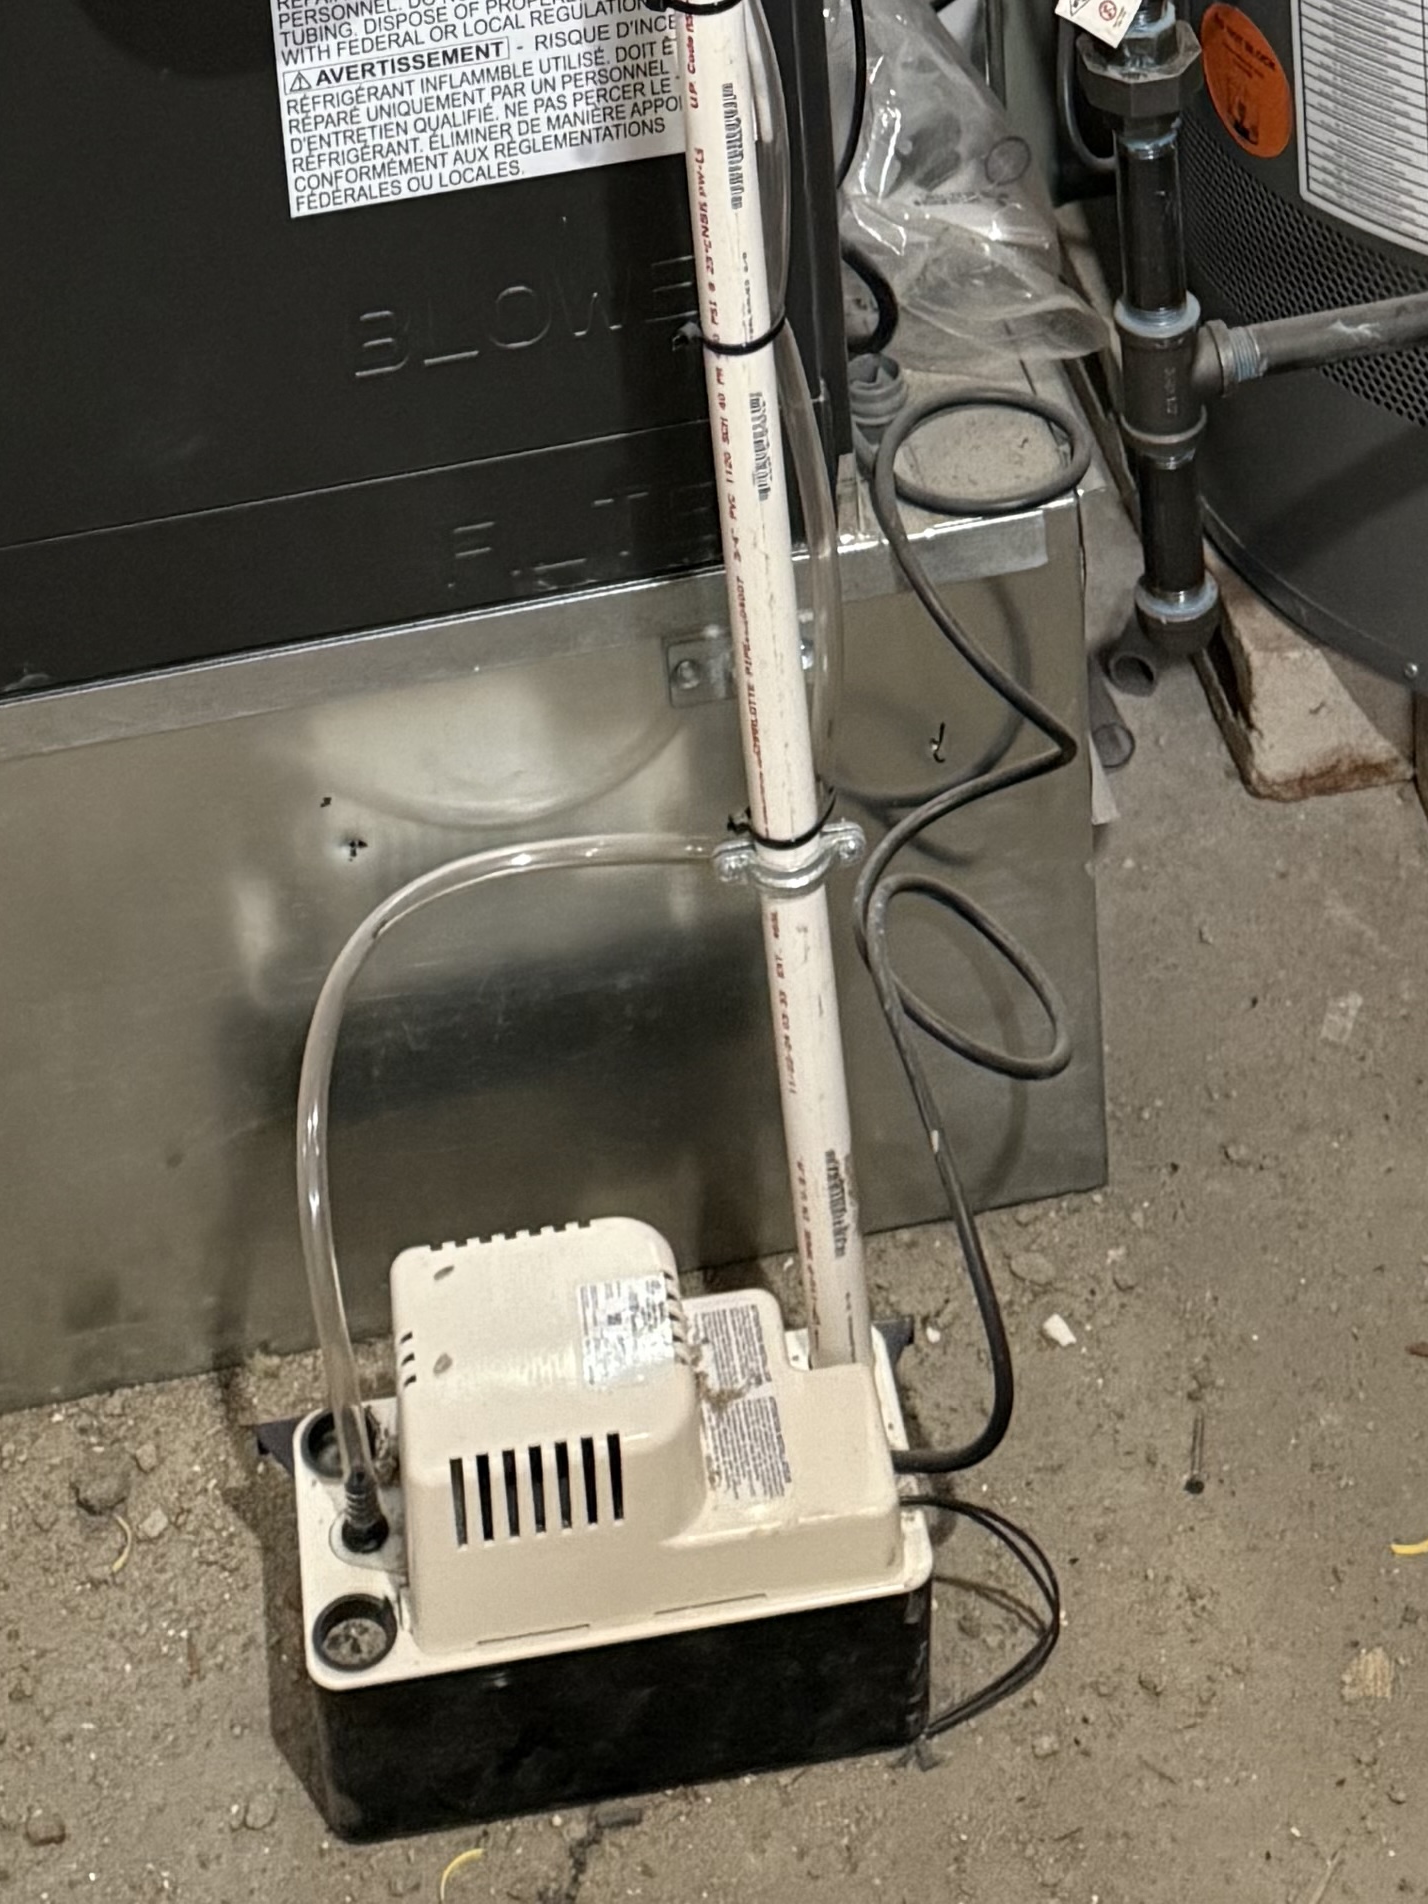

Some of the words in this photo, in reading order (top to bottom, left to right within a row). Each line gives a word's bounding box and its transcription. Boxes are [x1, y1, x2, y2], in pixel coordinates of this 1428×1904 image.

[281, 42, 330, 66] WITH
[336, 28, 424, 57] FEDERAL
[429, 23, 457, 42] OR
[462, 12, 524, 37] LOCAL
[315, 41, 504, 85] AVERTISSEMENT
[533, 23, 610, 53] RISQUE
[420, 59, 534, 93] INFLAMMBLE
[295, 175, 402, 210] FÉDÉRALES
[406, 172, 434, 192] OU
[438, 157, 524, 187] LOCALES.
